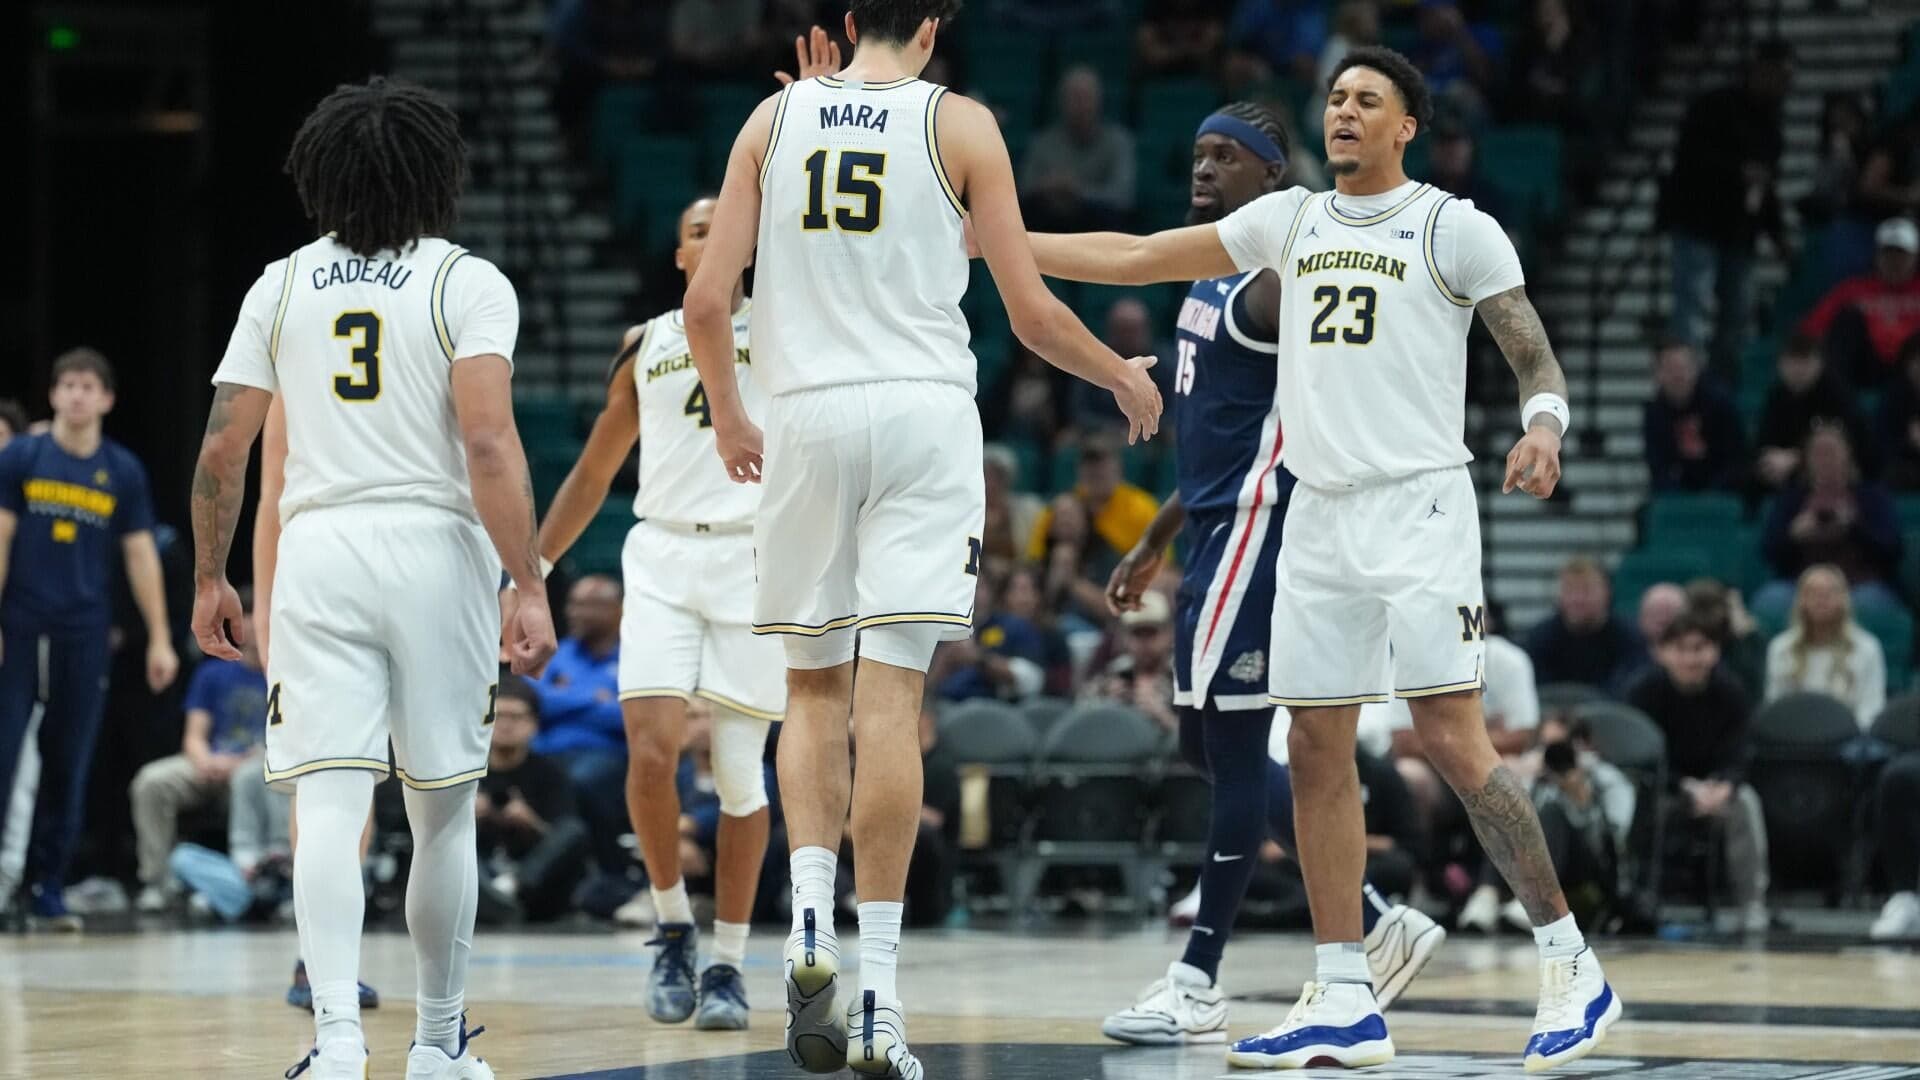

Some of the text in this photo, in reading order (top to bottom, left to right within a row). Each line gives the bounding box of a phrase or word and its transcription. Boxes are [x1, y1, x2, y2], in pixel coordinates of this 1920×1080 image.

[820, 103, 889, 134] MARA
[802, 148, 886, 234] 15
[312, 257, 413, 291] CADEAU
[1296, 250, 1408, 282] MICHIGAN
[1309, 284, 1378, 346] 23
[333, 310, 383, 402] 3
[645, 347, 751, 384] MICHN
[1174, 339, 1197, 397] 15
[683, 378, 713, 429] 4
[1456, 604, 1486, 643] M
